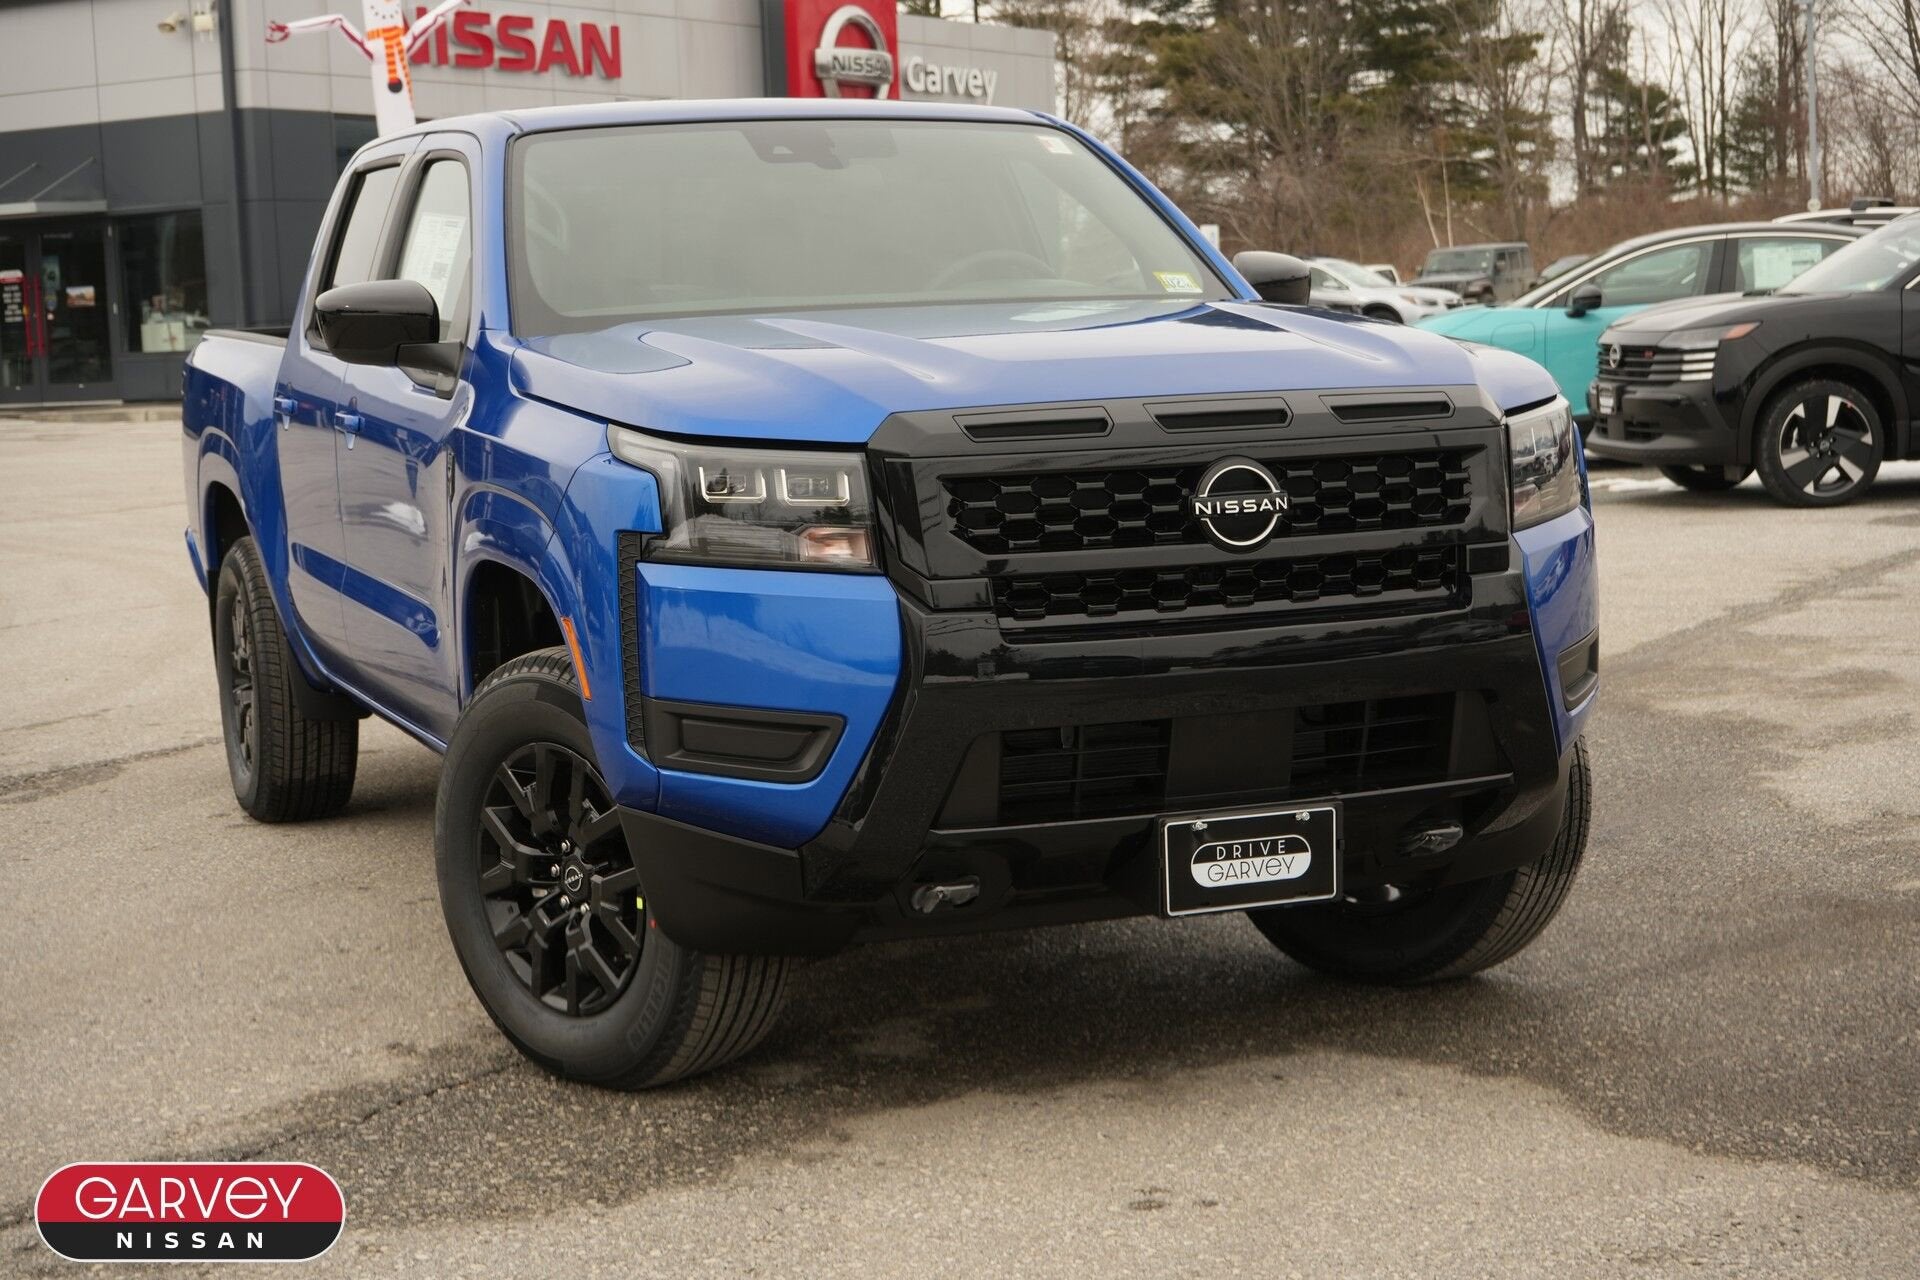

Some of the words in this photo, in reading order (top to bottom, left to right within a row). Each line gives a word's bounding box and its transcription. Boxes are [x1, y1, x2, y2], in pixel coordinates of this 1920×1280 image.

[906, 56, 998, 105] Garvey
[1195, 497, 1288, 515] NISSAN
[1216, 839, 1286, 861] DRIVE
